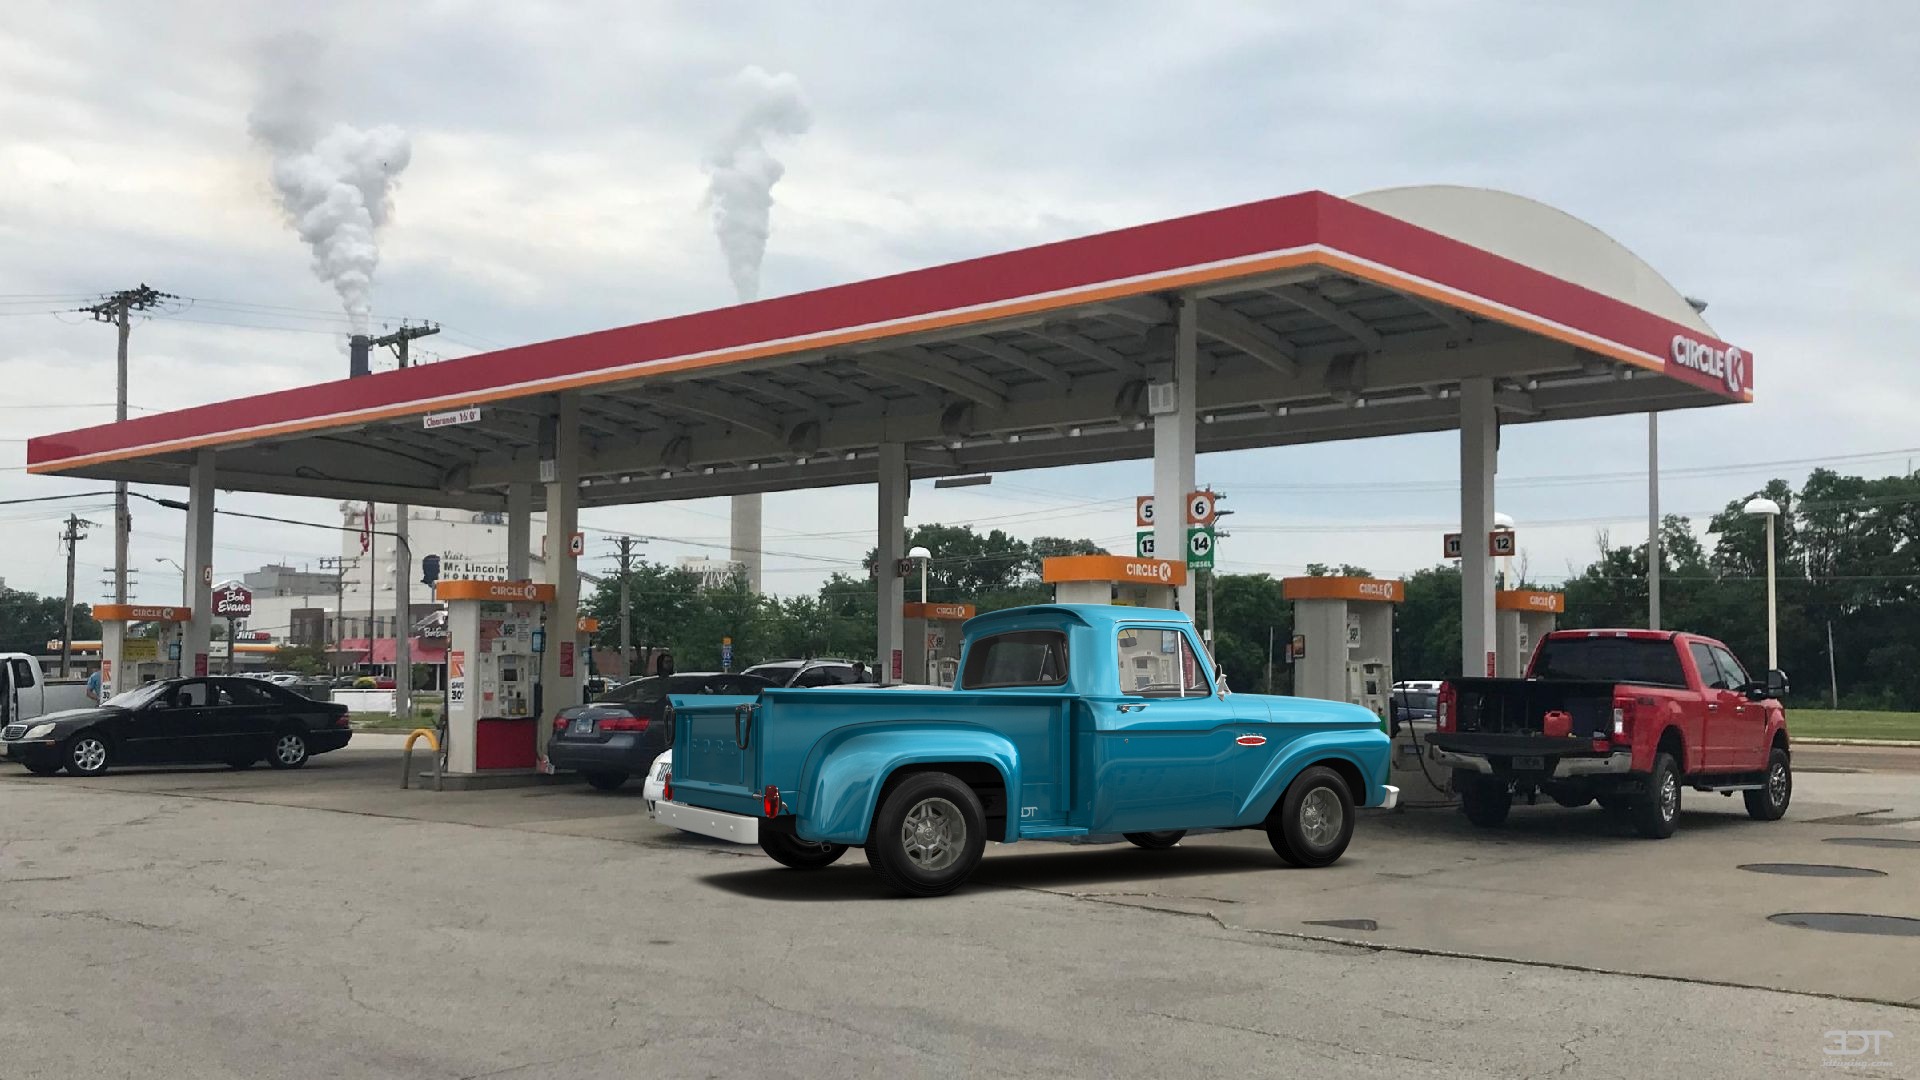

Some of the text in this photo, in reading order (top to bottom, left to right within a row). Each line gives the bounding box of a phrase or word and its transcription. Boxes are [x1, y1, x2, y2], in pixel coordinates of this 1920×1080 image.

[1671, 334, 1744, 392] CIRCLE K
[426, 415, 456, 427] Clearance
[1144, 505, 1153, 518] 5
[1195, 501, 1205, 515] 6
[1142, 539, 1154, 553] 13
[1193, 537, 1209, 551] 14
[1496, 538, 1509, 549] 12
[443, 562, 508, 574] Mr. Lincoln'
[1189, 560, 1212, 568] DIESEL
[443, 573, 508, 581] HOMETOW
[1126, 562, 1172, 582] CIRCLE K
[224, 591, 245, 602] Bob
[490, 584, 537, 599] CIRCLE K
[1359, 582, 1393, 599] CIRCLE K
[132, 607, 174, 619] CIRCLE K
[217, 600, 251, 613] Evans
